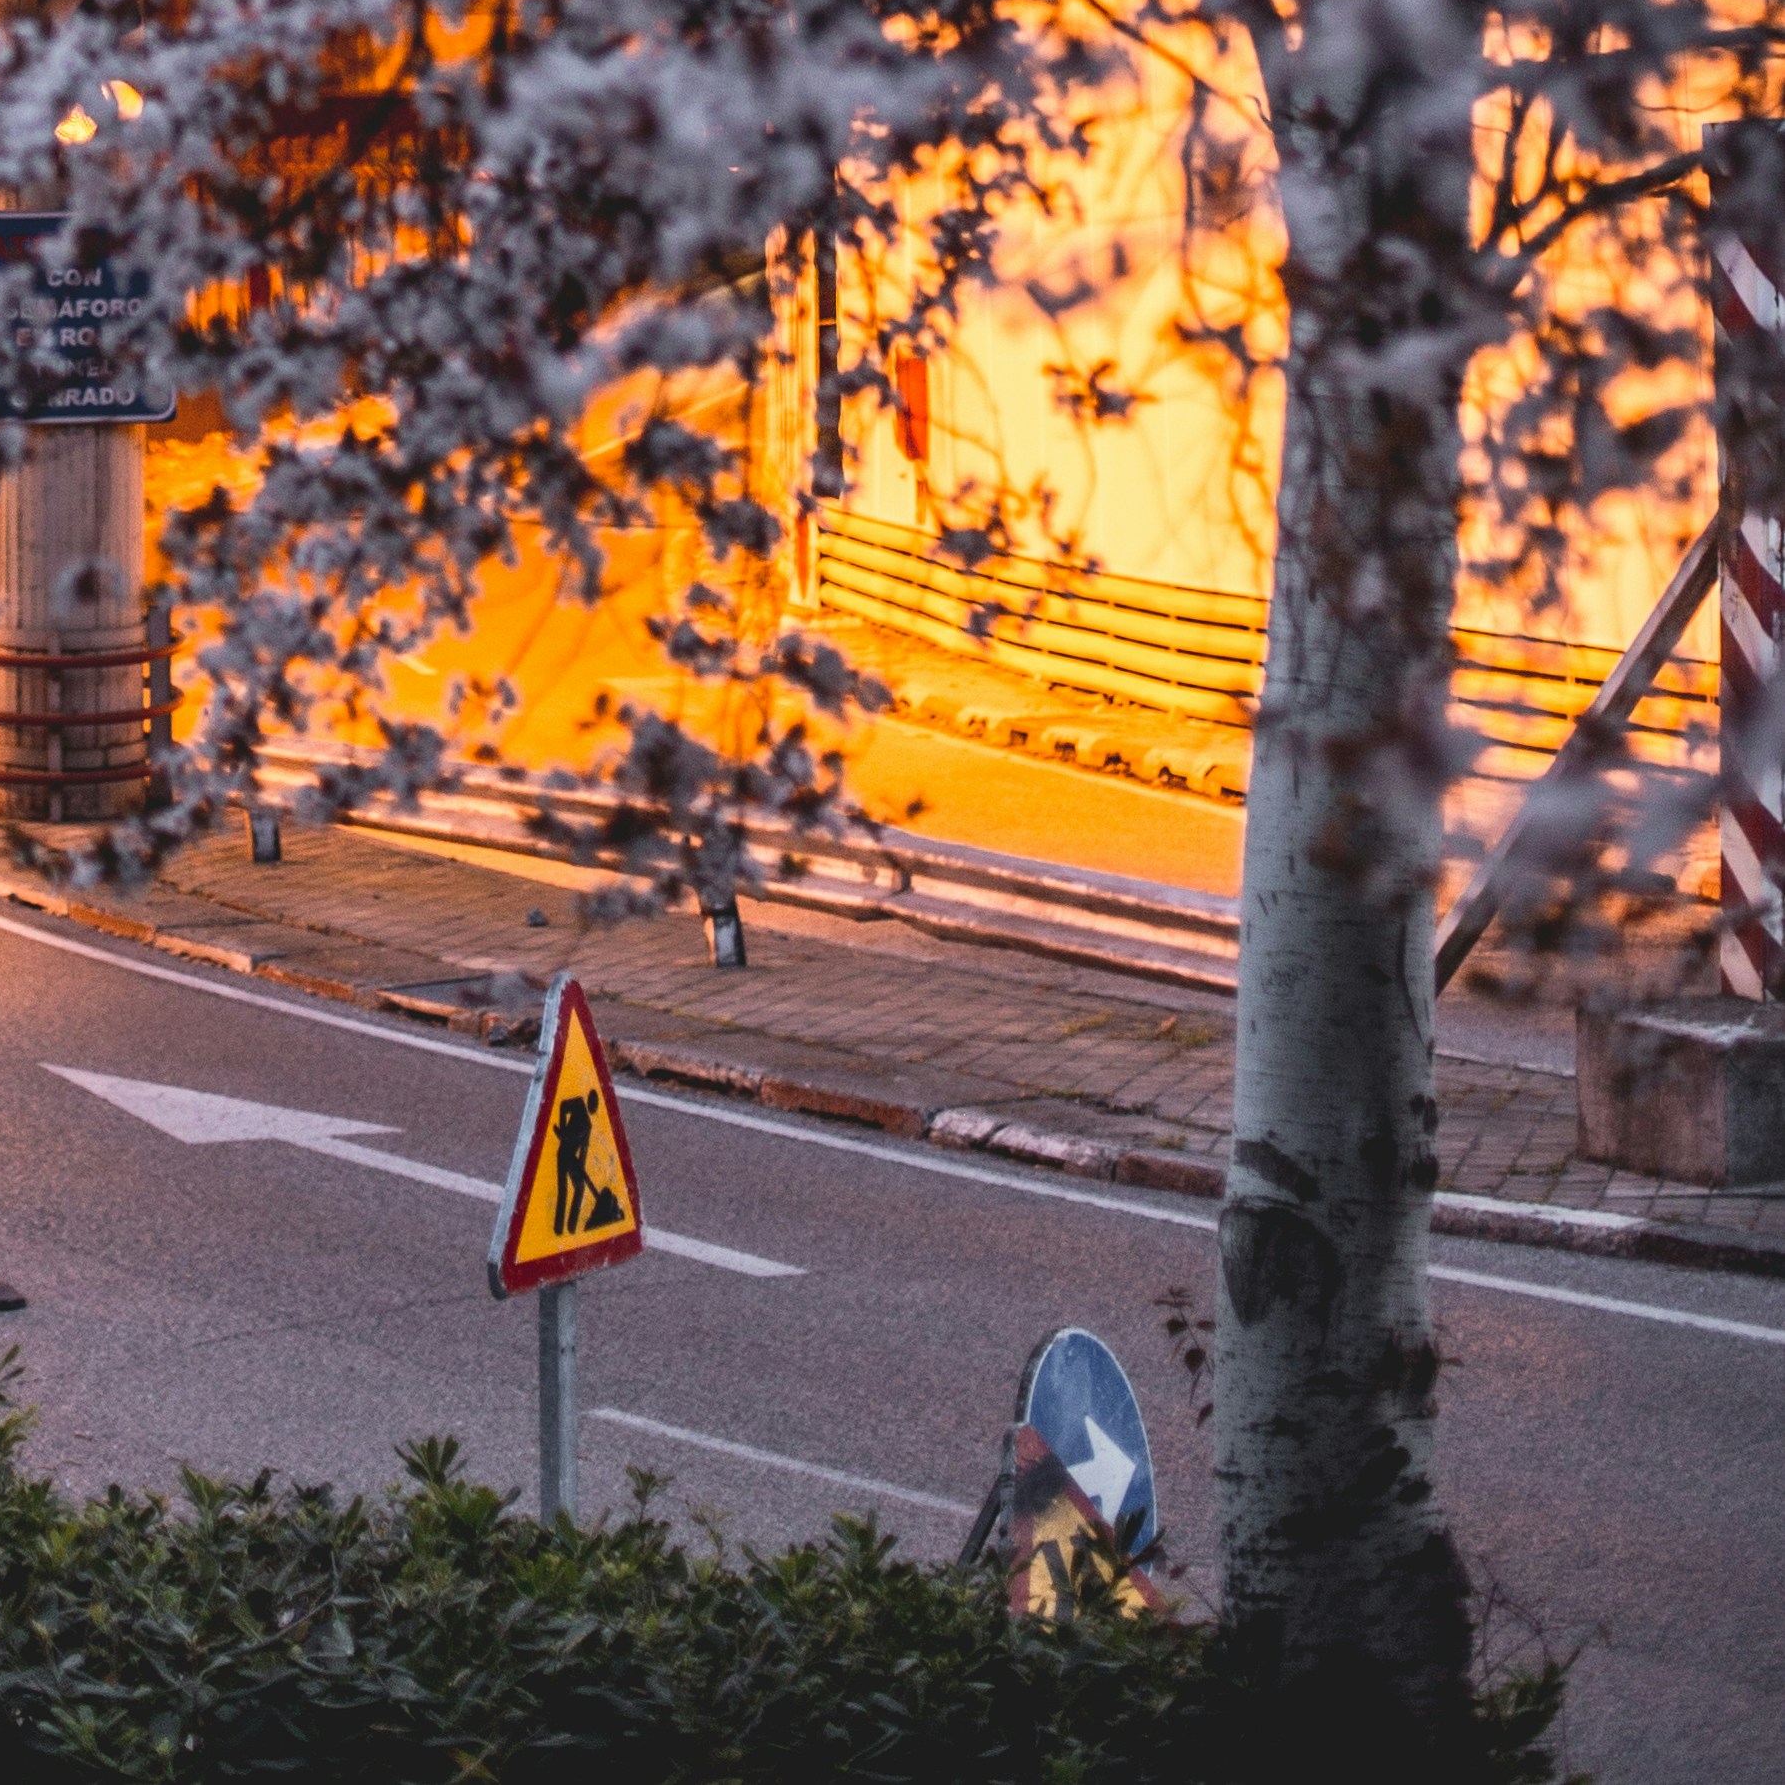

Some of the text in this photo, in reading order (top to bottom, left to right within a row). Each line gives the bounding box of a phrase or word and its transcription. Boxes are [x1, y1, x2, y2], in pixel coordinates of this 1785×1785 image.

[45, 267, 103, 288] CON
[6, 296, 143, 320] ÁFORO
[10, 386, 136, 408] RADO
